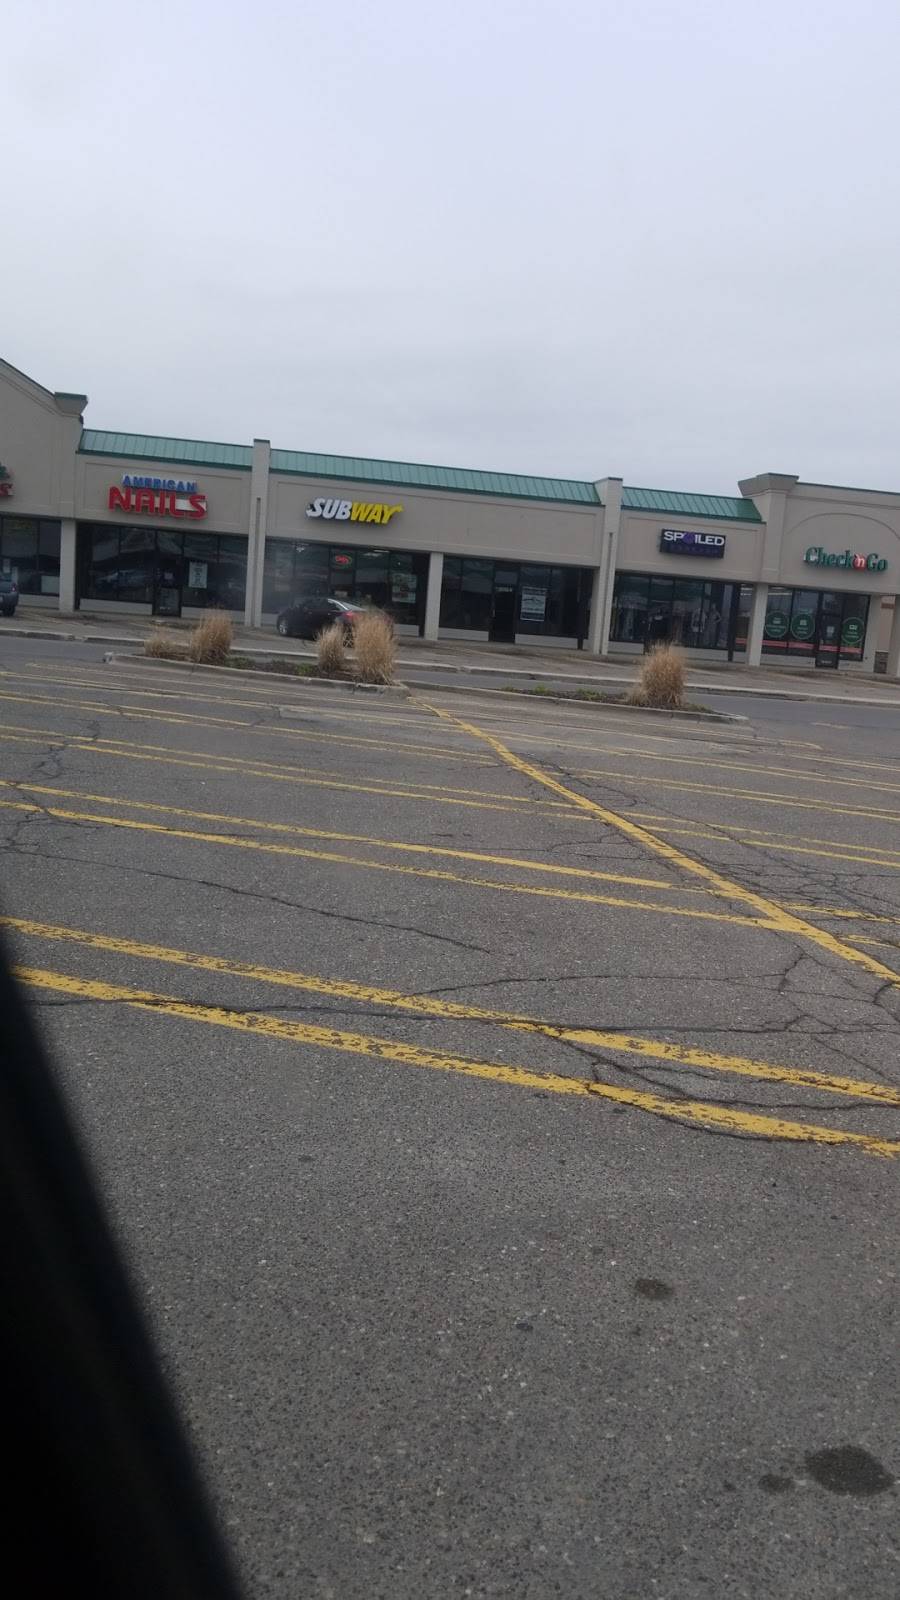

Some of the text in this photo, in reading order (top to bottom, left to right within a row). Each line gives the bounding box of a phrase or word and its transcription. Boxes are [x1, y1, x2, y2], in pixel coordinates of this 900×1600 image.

[122, 474, 197, 493] AMERICAN
[108, 485, 207, 519] NAILS
[306, 498, 402, 524] SUBWAY
[805, 546, 853, 568] Check
[867, 553, 888, 572] Go
